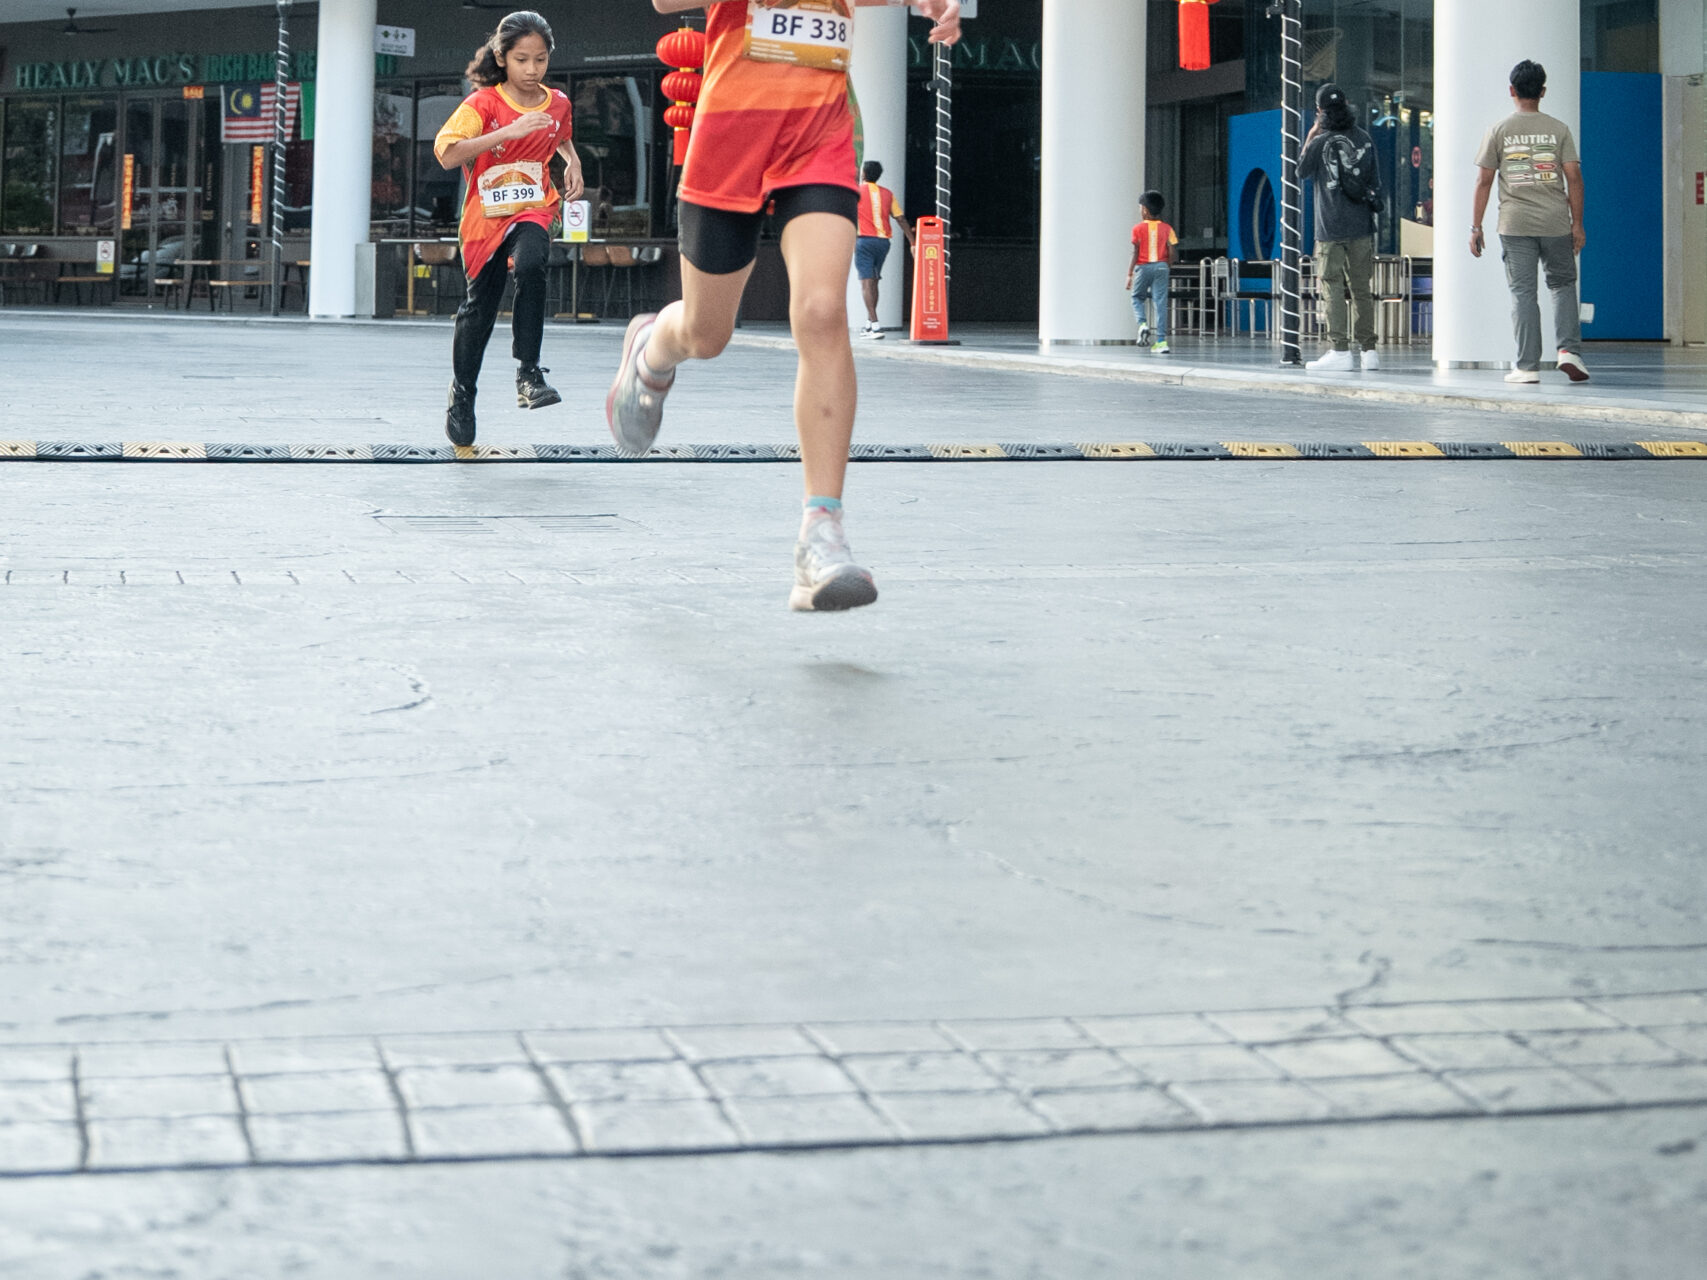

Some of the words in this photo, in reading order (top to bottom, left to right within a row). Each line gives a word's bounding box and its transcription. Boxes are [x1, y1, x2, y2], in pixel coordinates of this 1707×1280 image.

[771, 13, 804, 37] BF
[810, 18, 847, 43] 338
[16, 60, 101, 90] HEALY
[113, 52, 195, 87] MAC'S
[204, 54, 244, 82] IRISH
[1504, 134, 1556, 146] NAUTICA
[492, 189, 508, 203] BF
[512, 187, 535, 201] 399
